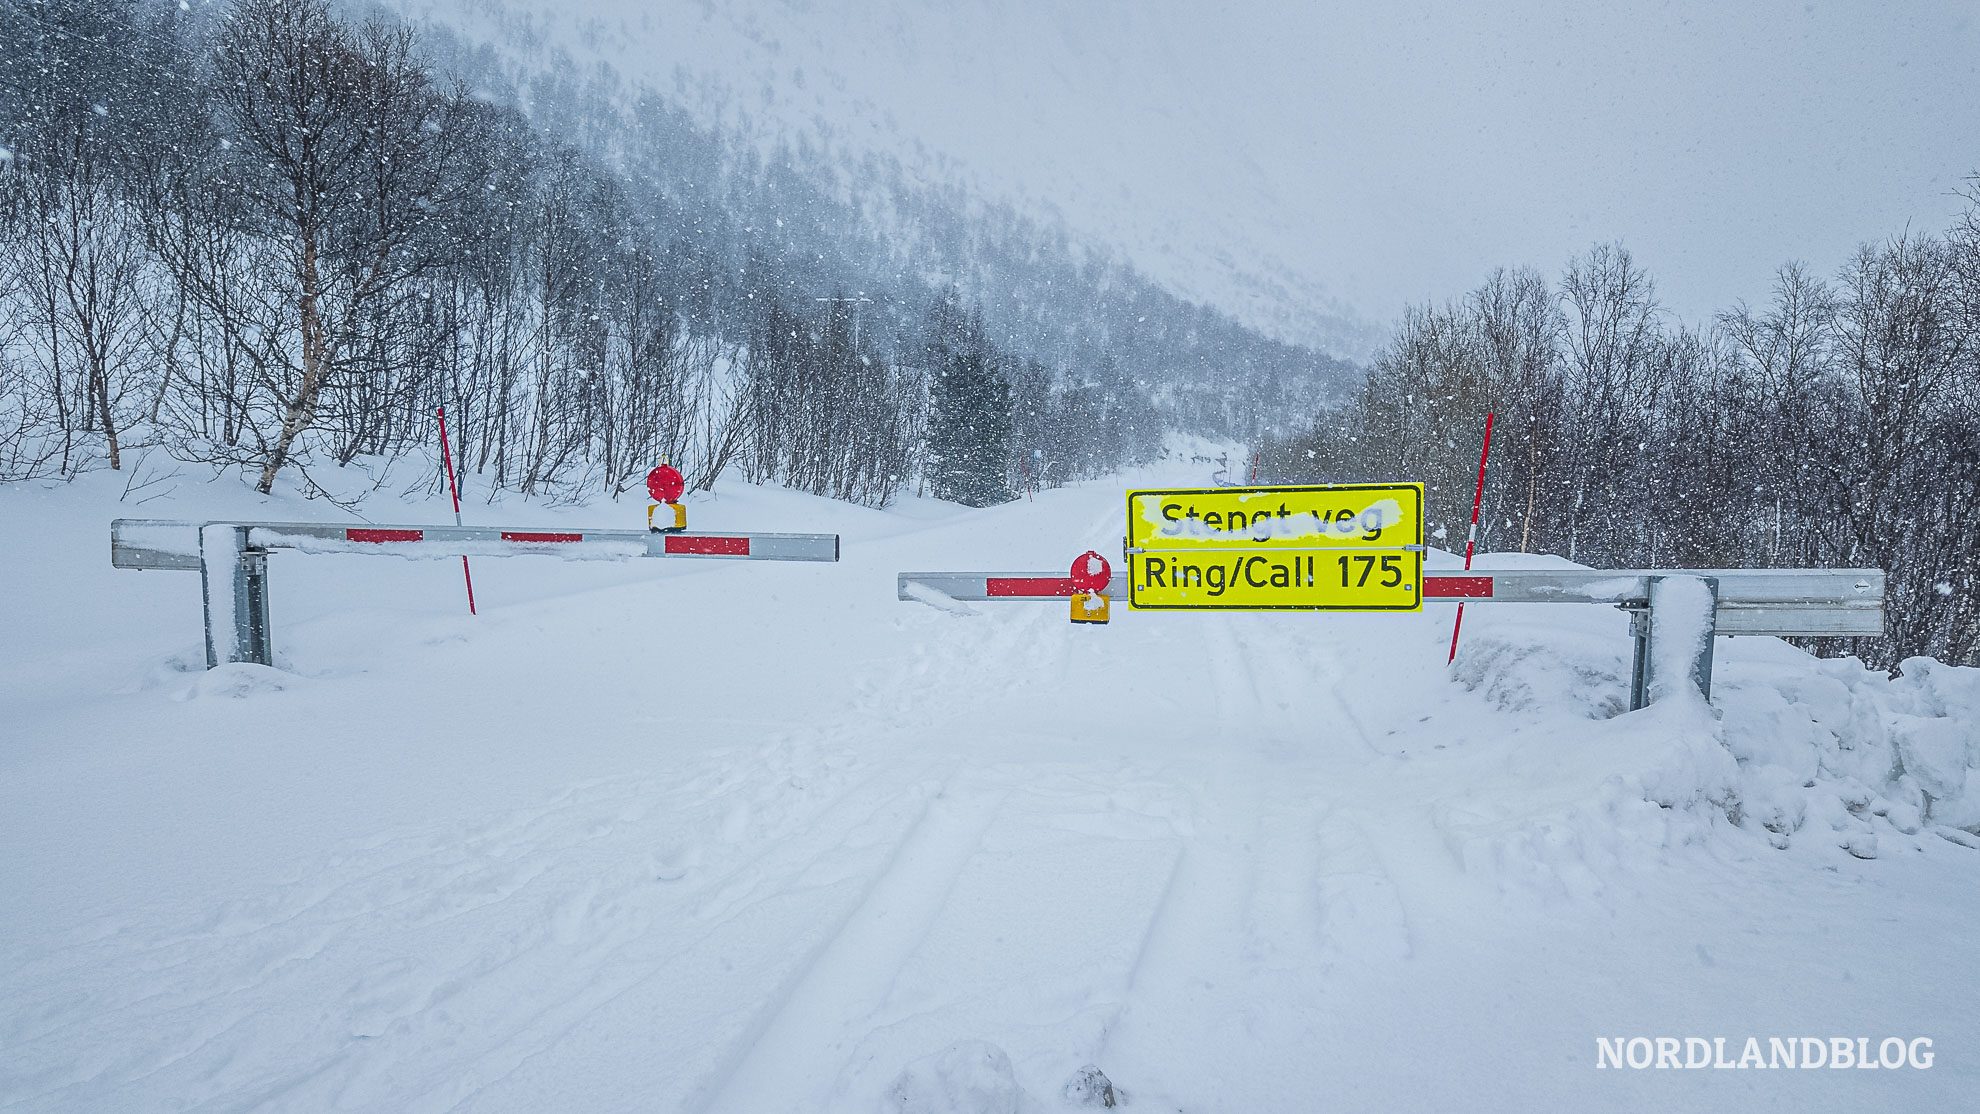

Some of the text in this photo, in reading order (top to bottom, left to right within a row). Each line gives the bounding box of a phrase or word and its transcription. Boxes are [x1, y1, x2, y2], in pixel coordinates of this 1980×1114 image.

[1160, 502, 1383, 542] Stengt veg
[1145, 555, 1402, 596] Ring/Call 175
